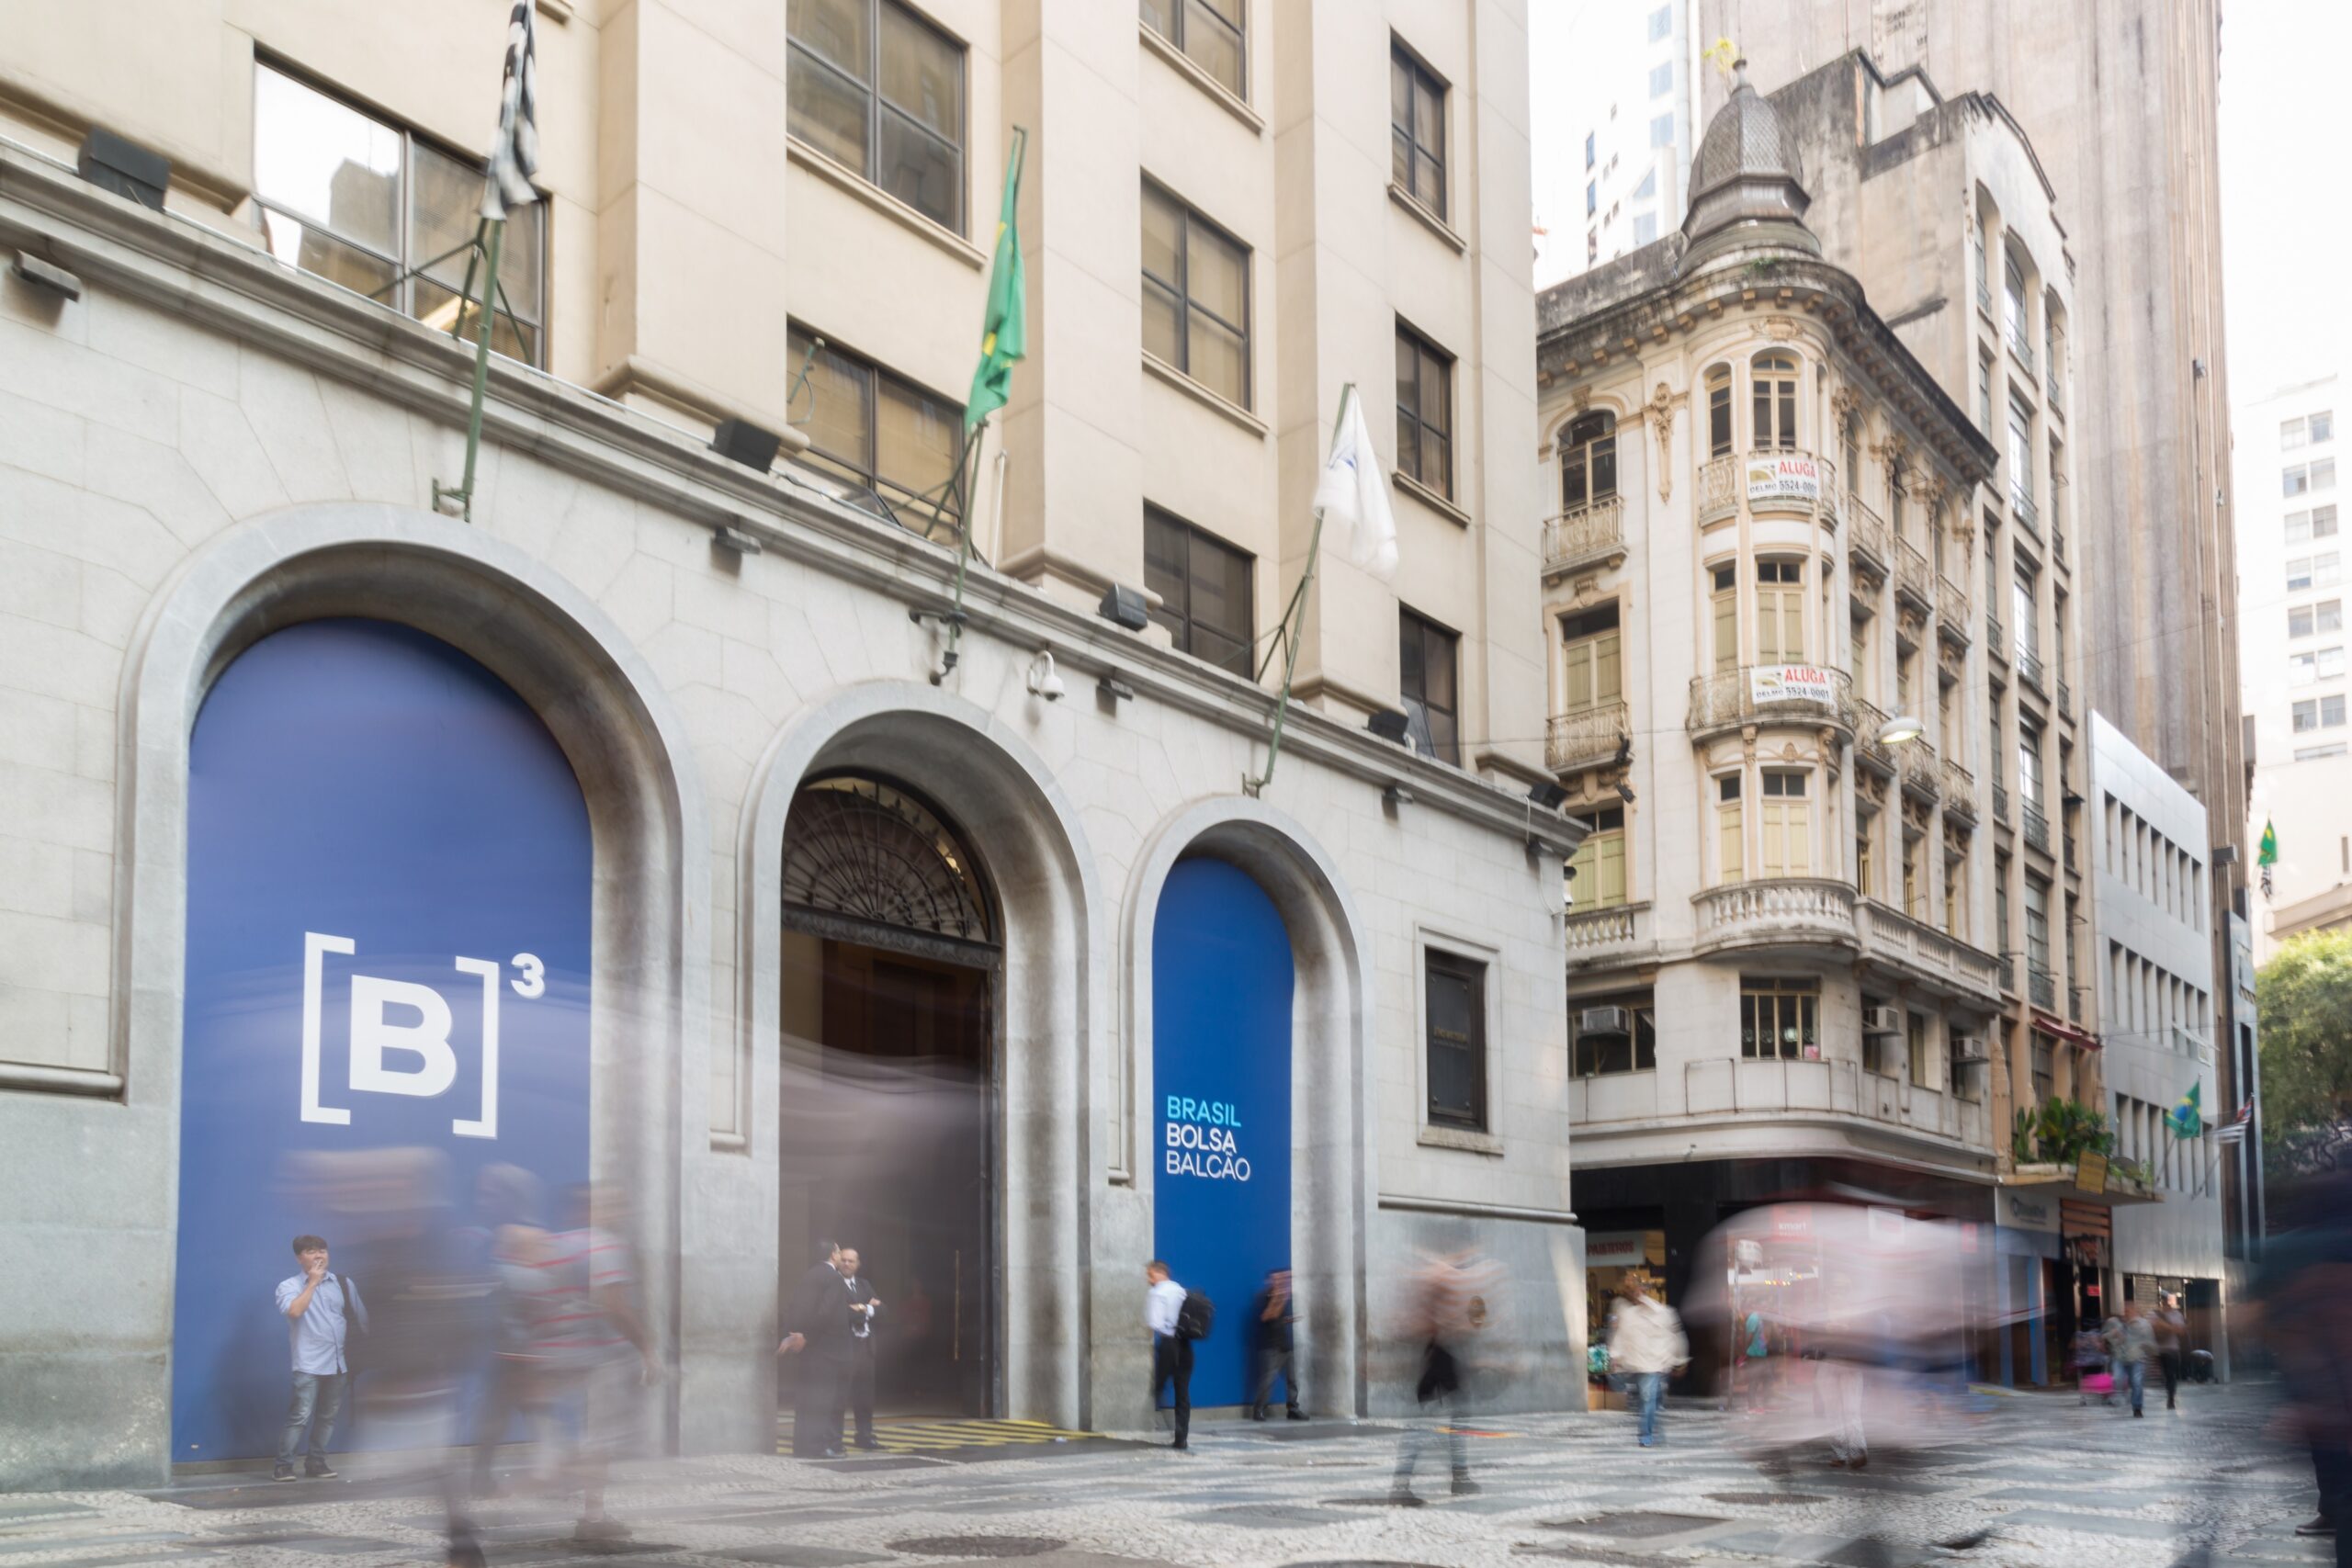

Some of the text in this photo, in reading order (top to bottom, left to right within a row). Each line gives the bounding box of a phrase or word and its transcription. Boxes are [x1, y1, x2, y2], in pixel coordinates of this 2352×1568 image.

[1779, 459, 1816, 479] ALUGA
[1785, 668, 1826, 684] ALUGA
[1167, 1095, 1242, 1128] BRASIL
[1166, 1122, 1238, 1155] BOLSA
[1166, 1149, 1251, 1182] BALCÃO
